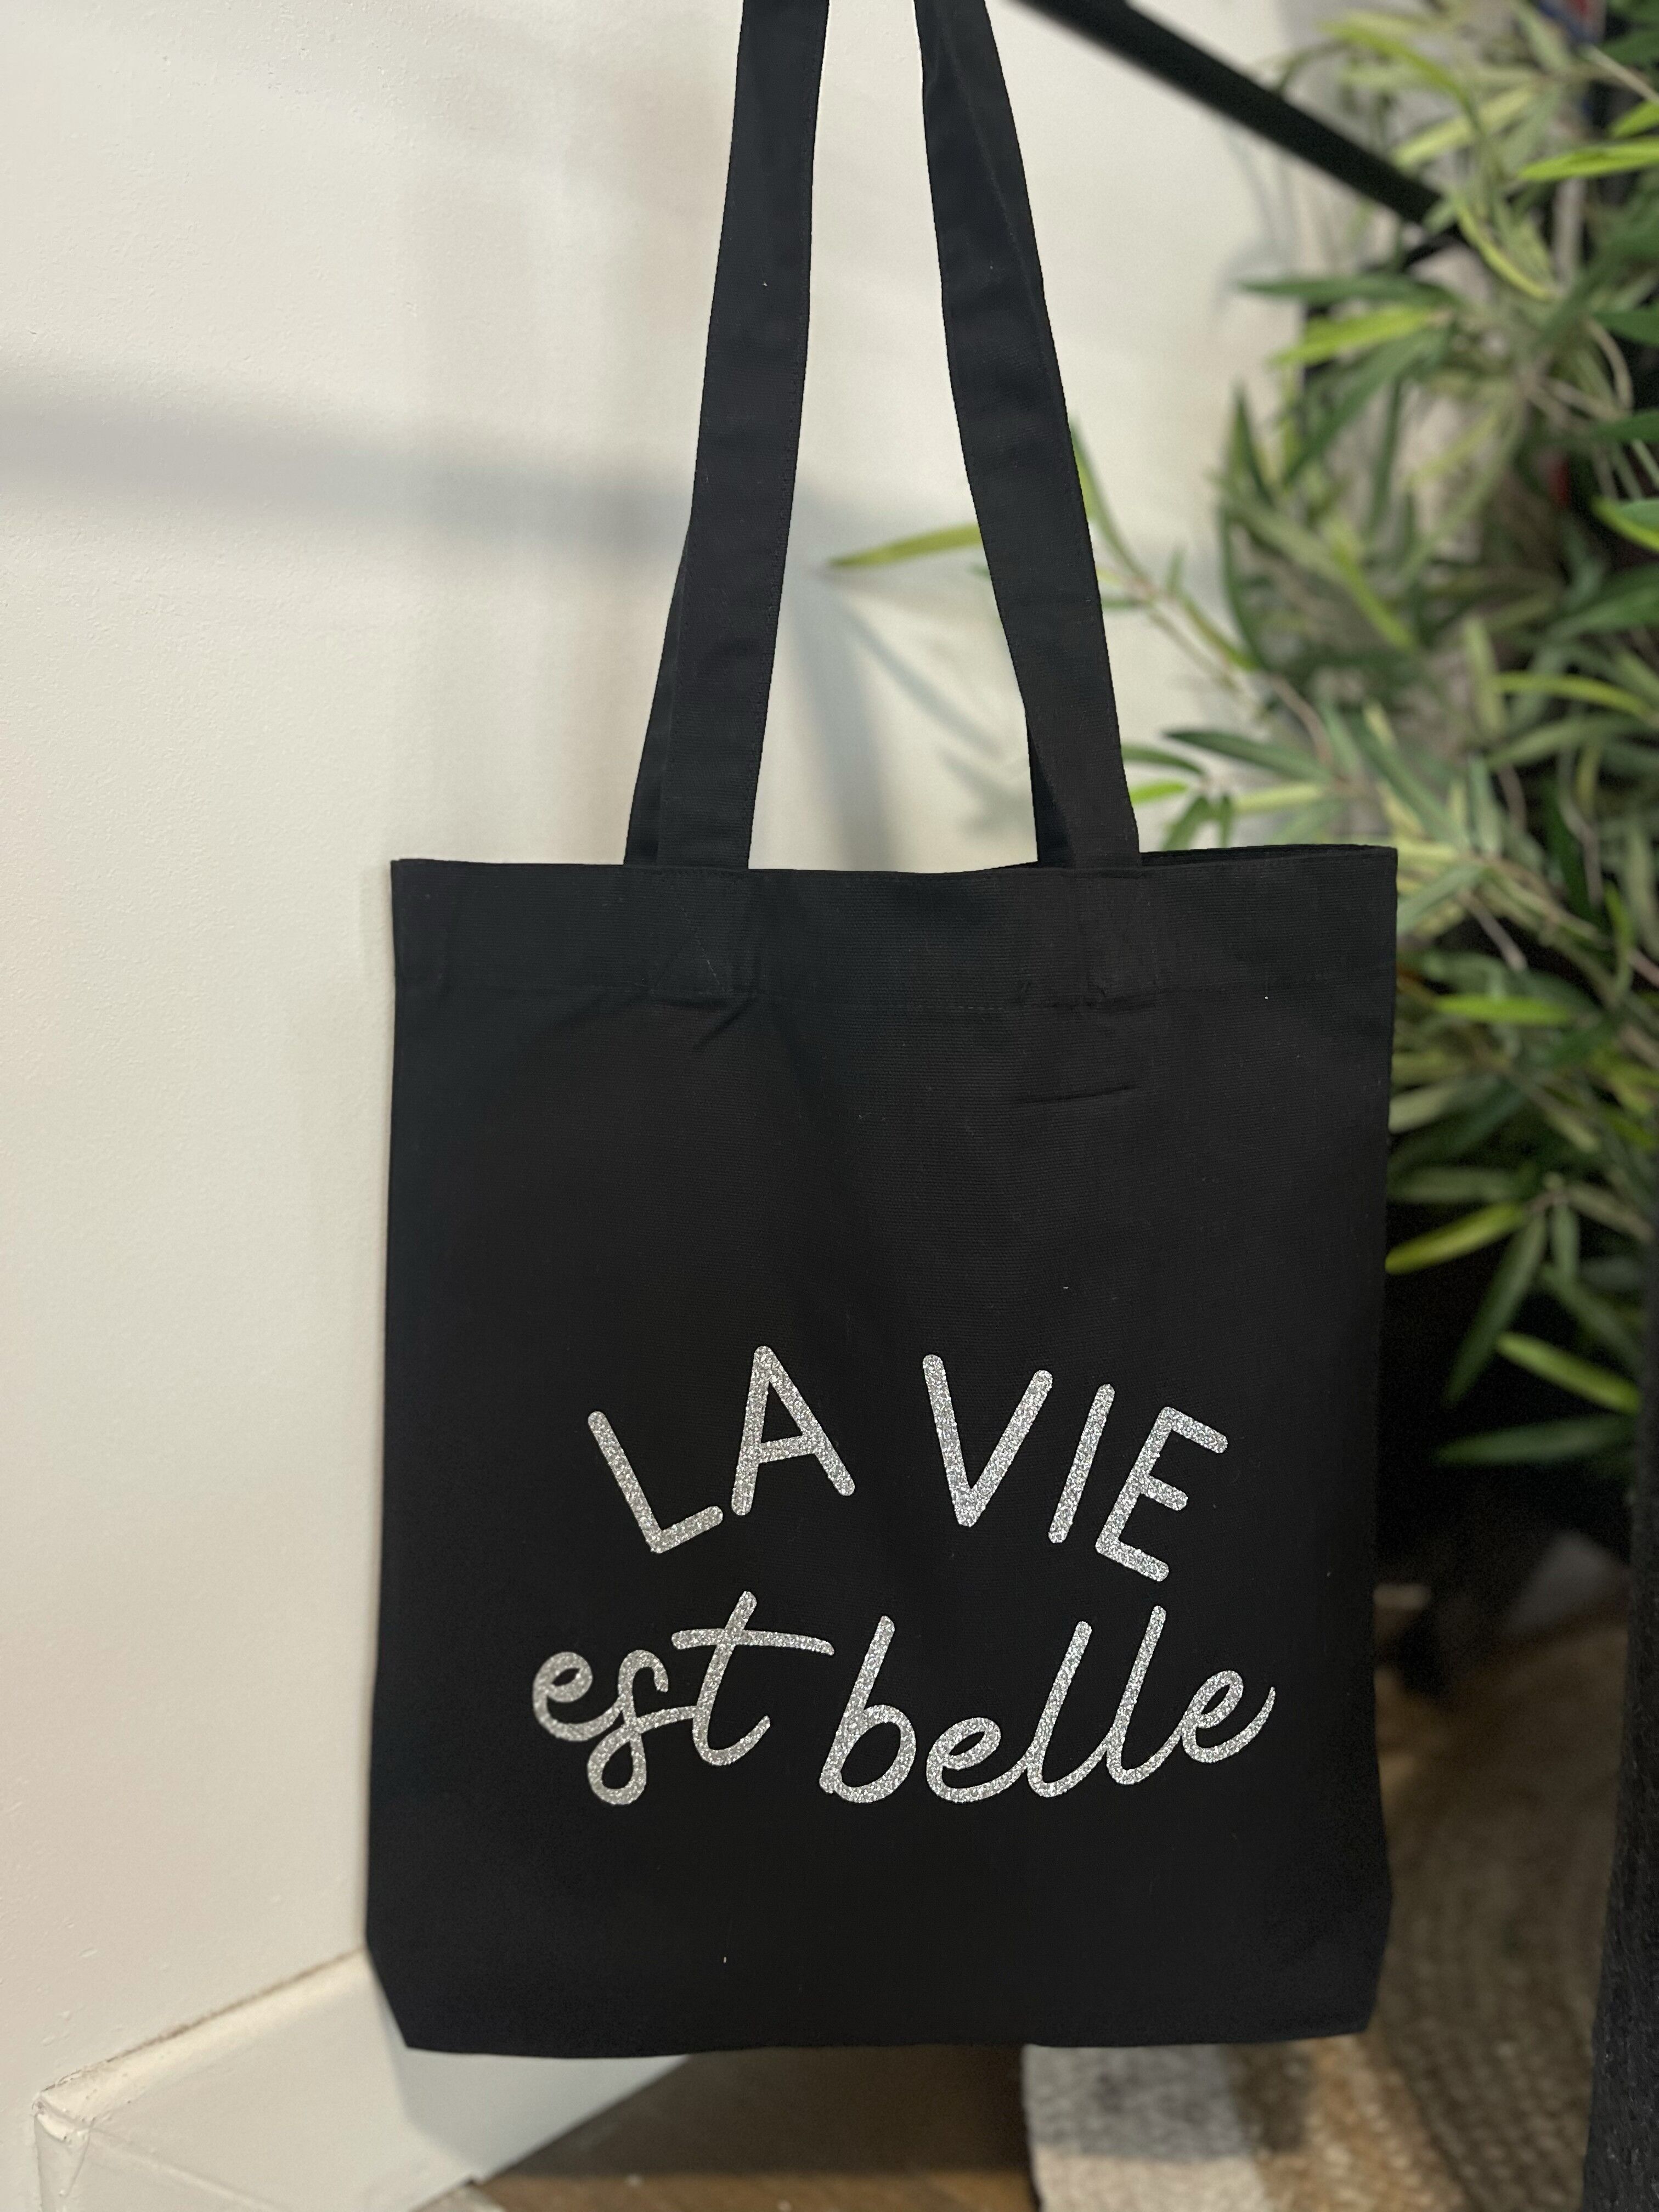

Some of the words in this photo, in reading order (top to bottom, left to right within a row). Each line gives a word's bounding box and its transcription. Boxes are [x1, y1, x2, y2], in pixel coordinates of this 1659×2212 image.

[588, 1346, 855, 1554] LA
[922, 1355, 1228, 1582] VIE
[533, 1592, 834, 1805] est
[820, 1606, 1276, 1803] belle
